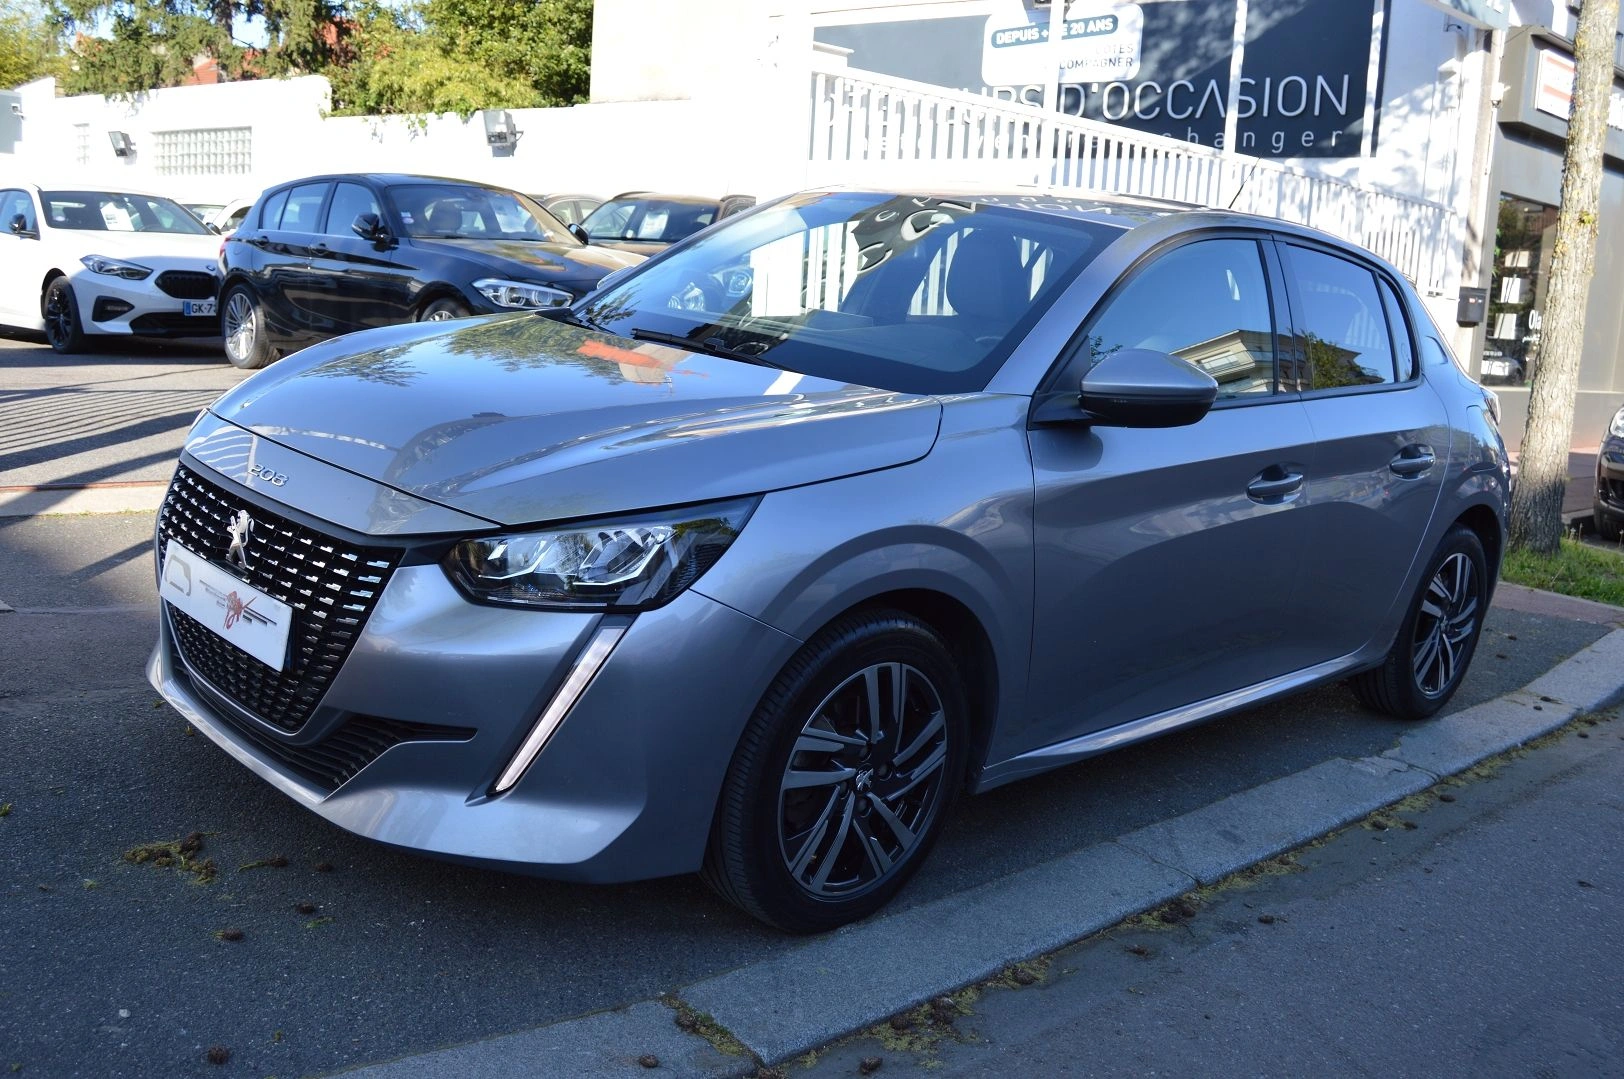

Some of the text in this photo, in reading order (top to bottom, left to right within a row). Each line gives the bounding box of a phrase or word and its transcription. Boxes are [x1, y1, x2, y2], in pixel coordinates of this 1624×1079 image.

[996, 28, 1040, 44] DEPUIS
[1070, 23, 1083, 35] 20
[1087, 18, 1114, 33] ANS
[1060, 74, 1349, 120] D'OCCASION
[248, 464, 289, 487] 208
